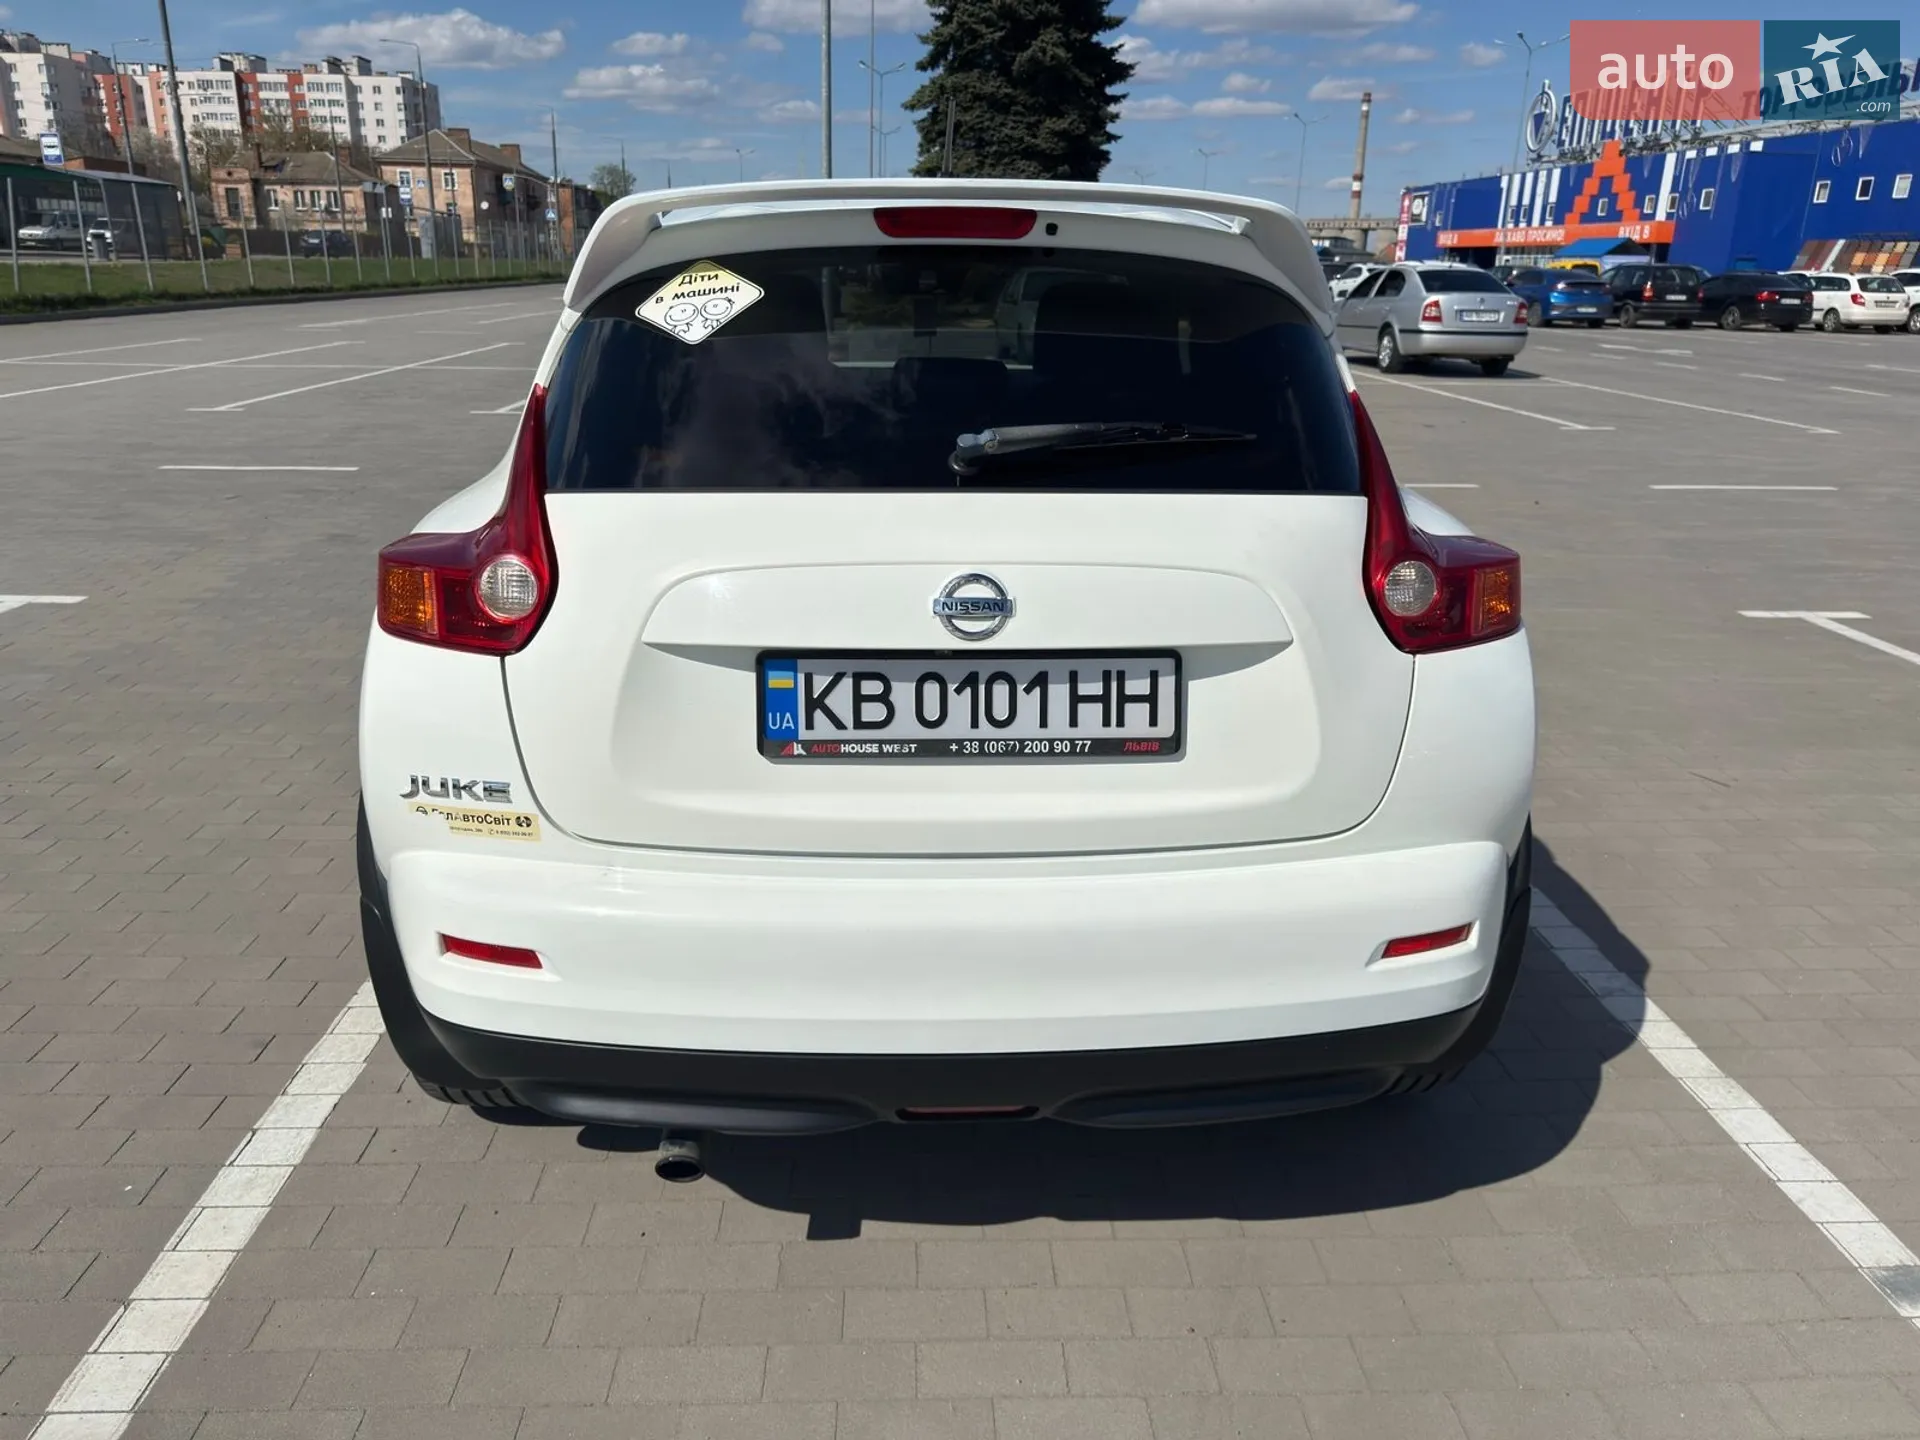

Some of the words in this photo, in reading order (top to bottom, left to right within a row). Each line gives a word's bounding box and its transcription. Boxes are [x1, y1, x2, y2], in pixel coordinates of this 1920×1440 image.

[678, 272, 719, 287] Діти
[672, 281, 741, 301] машині
[942, 601, 1004, 612] NISSAN
[804, 671, 896, 731] KB
[914, 670, 1049, 730] 0101
[1068, 669, 1159, 728] HH
[768, 711, 795, 730] UA
[963, 741, 980, 754] 38
[984, 740, 1019, 755] (067)
[1024, 740, 1049, 754] 200
[1053, 740, 1071, 754] 90
[1075, 739, 1092, 753] 77
[1123, 741, 1161, 753] ЛЬВІВ
[399, 774, 513, 803] JUKE
